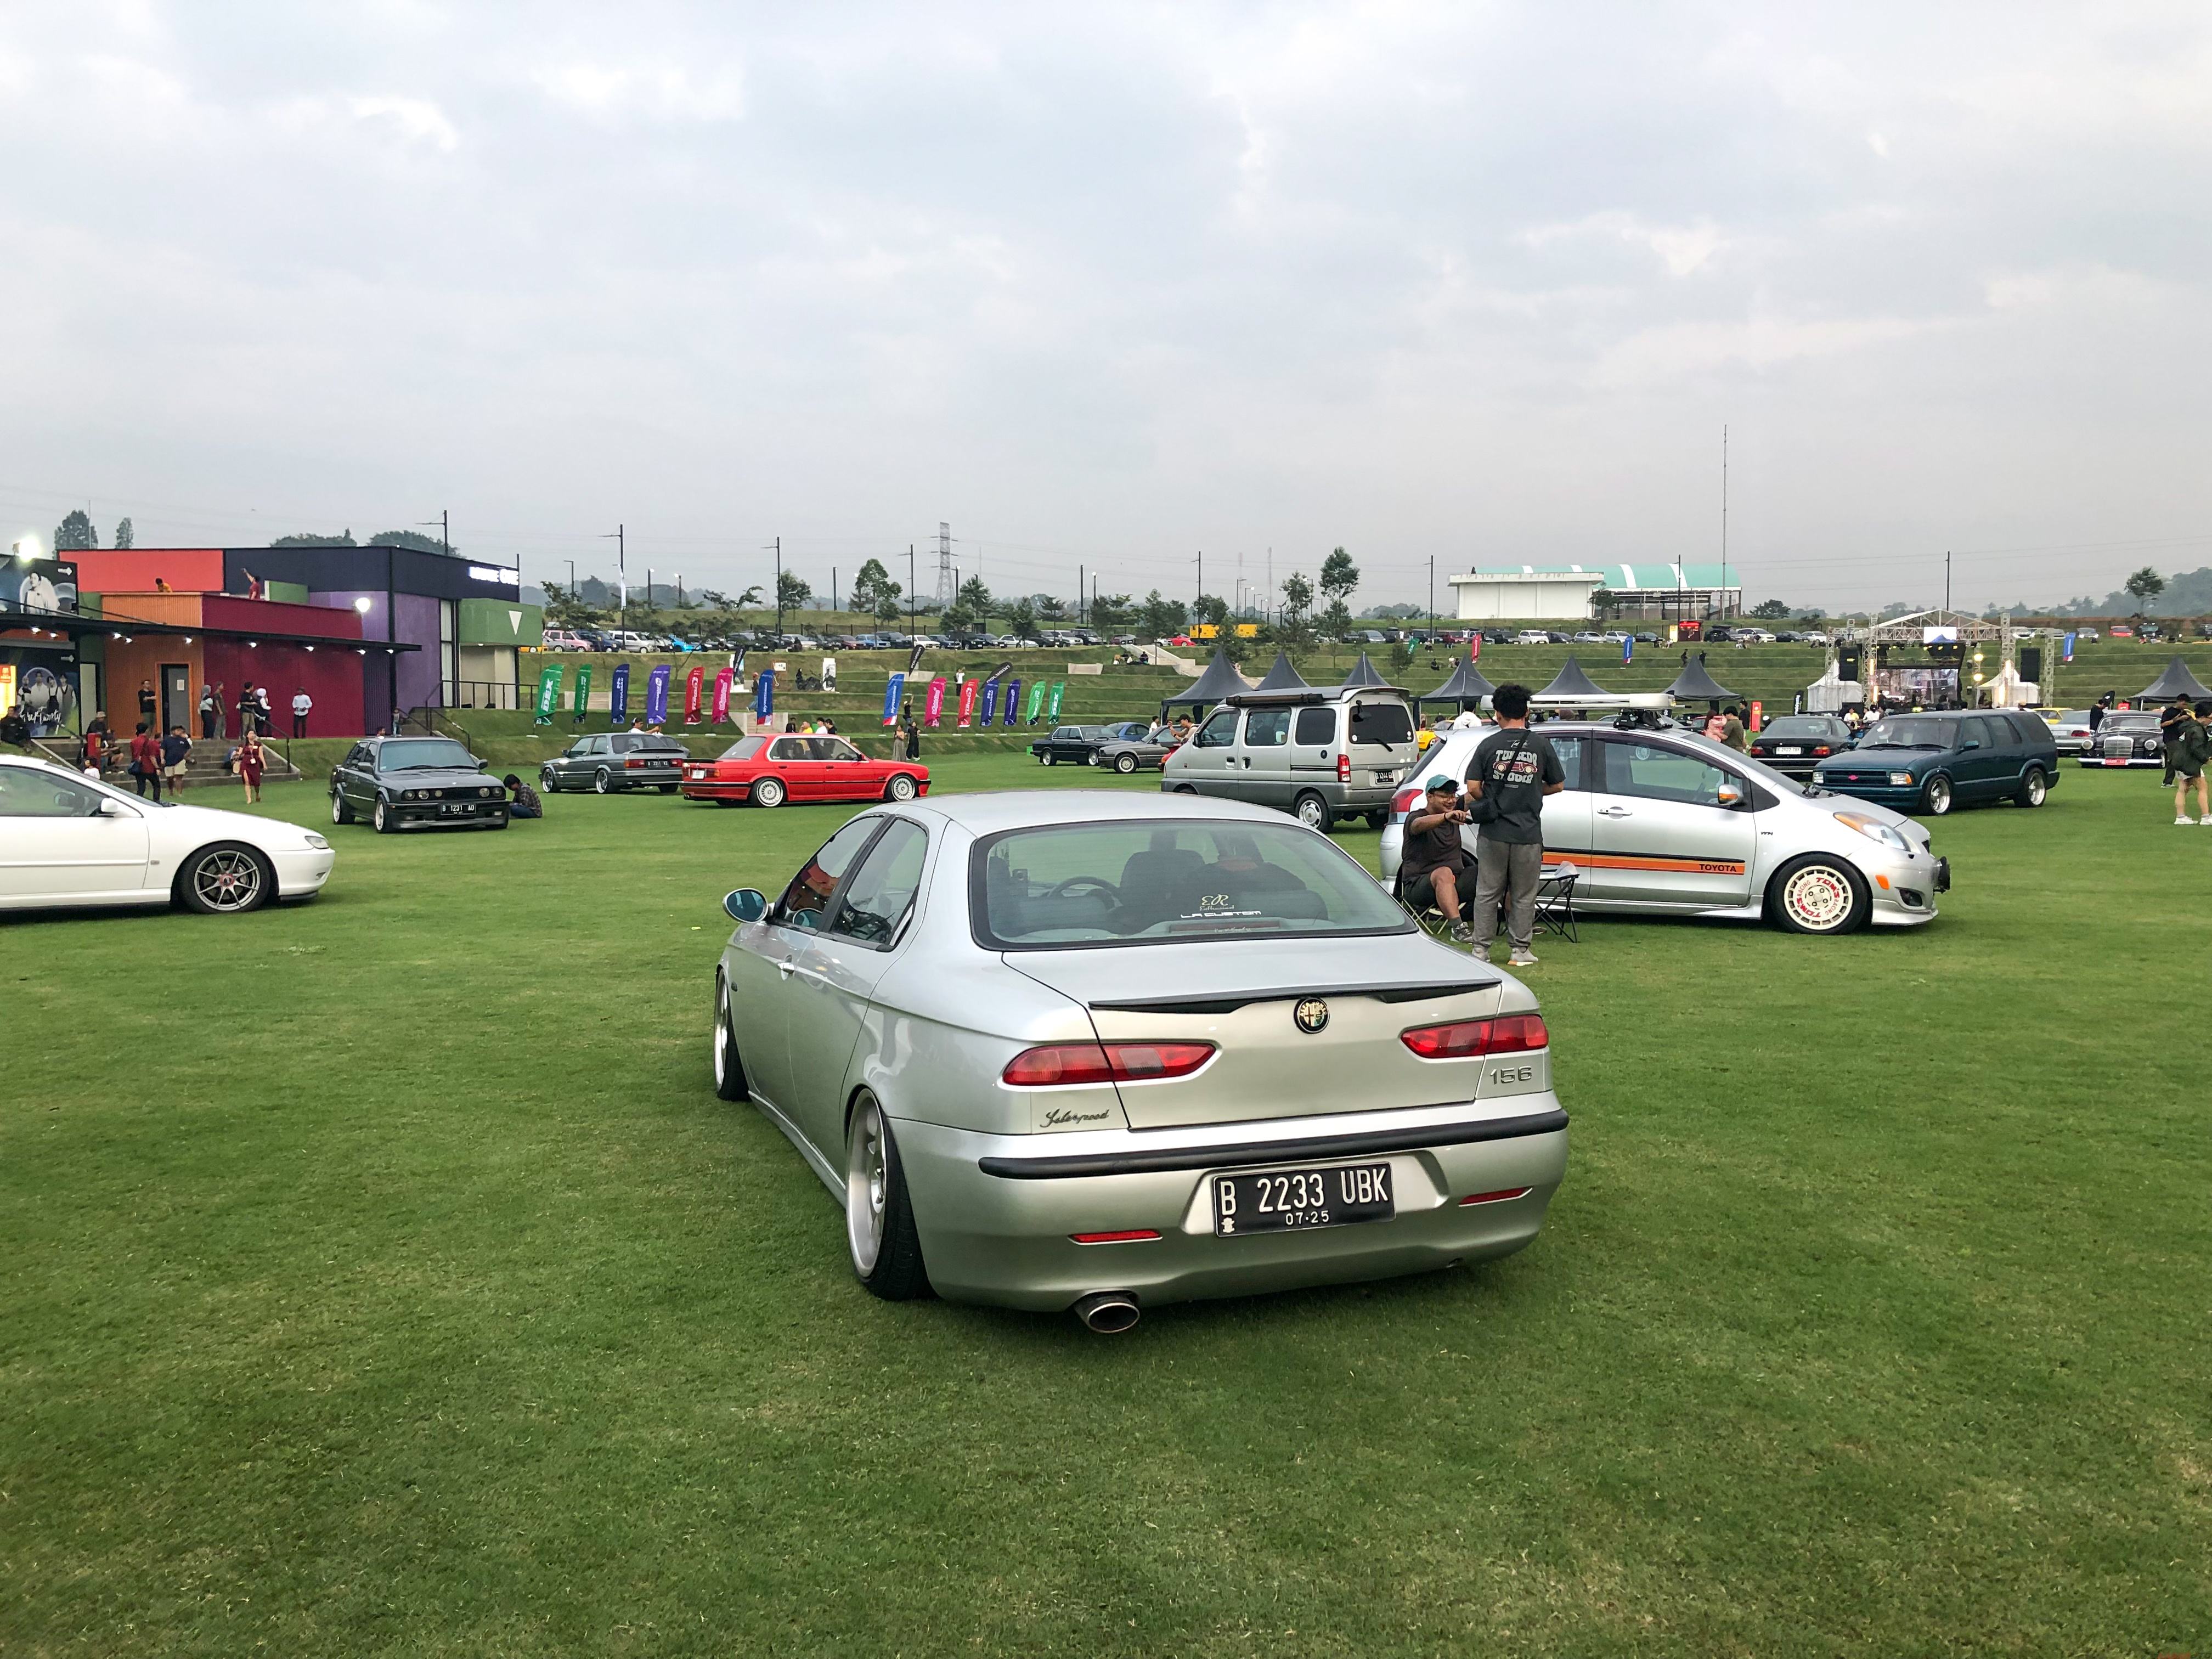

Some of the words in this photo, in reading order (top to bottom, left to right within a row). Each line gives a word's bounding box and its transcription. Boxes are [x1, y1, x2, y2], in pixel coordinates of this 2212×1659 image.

[986, 664, 1011, 684] POLYGON
[543, 678, 554, 712] DEX
[1699, 864, 1736, 872] TOYOTA
[1797, 880, 1811, 896] RACING
[1816, 877, 1840, 898] TOM'S
[1796, 898, 1821, 918] TOM'S
[1825, 899, 1839, 916] RACING
[1489, 1065, 1532, 1085] 156
[1220, 1181, 1237, 1216] B
[1257, 1173, 1324, 1213] 2233
[1340, 1167, 1389, 1204] UBK
